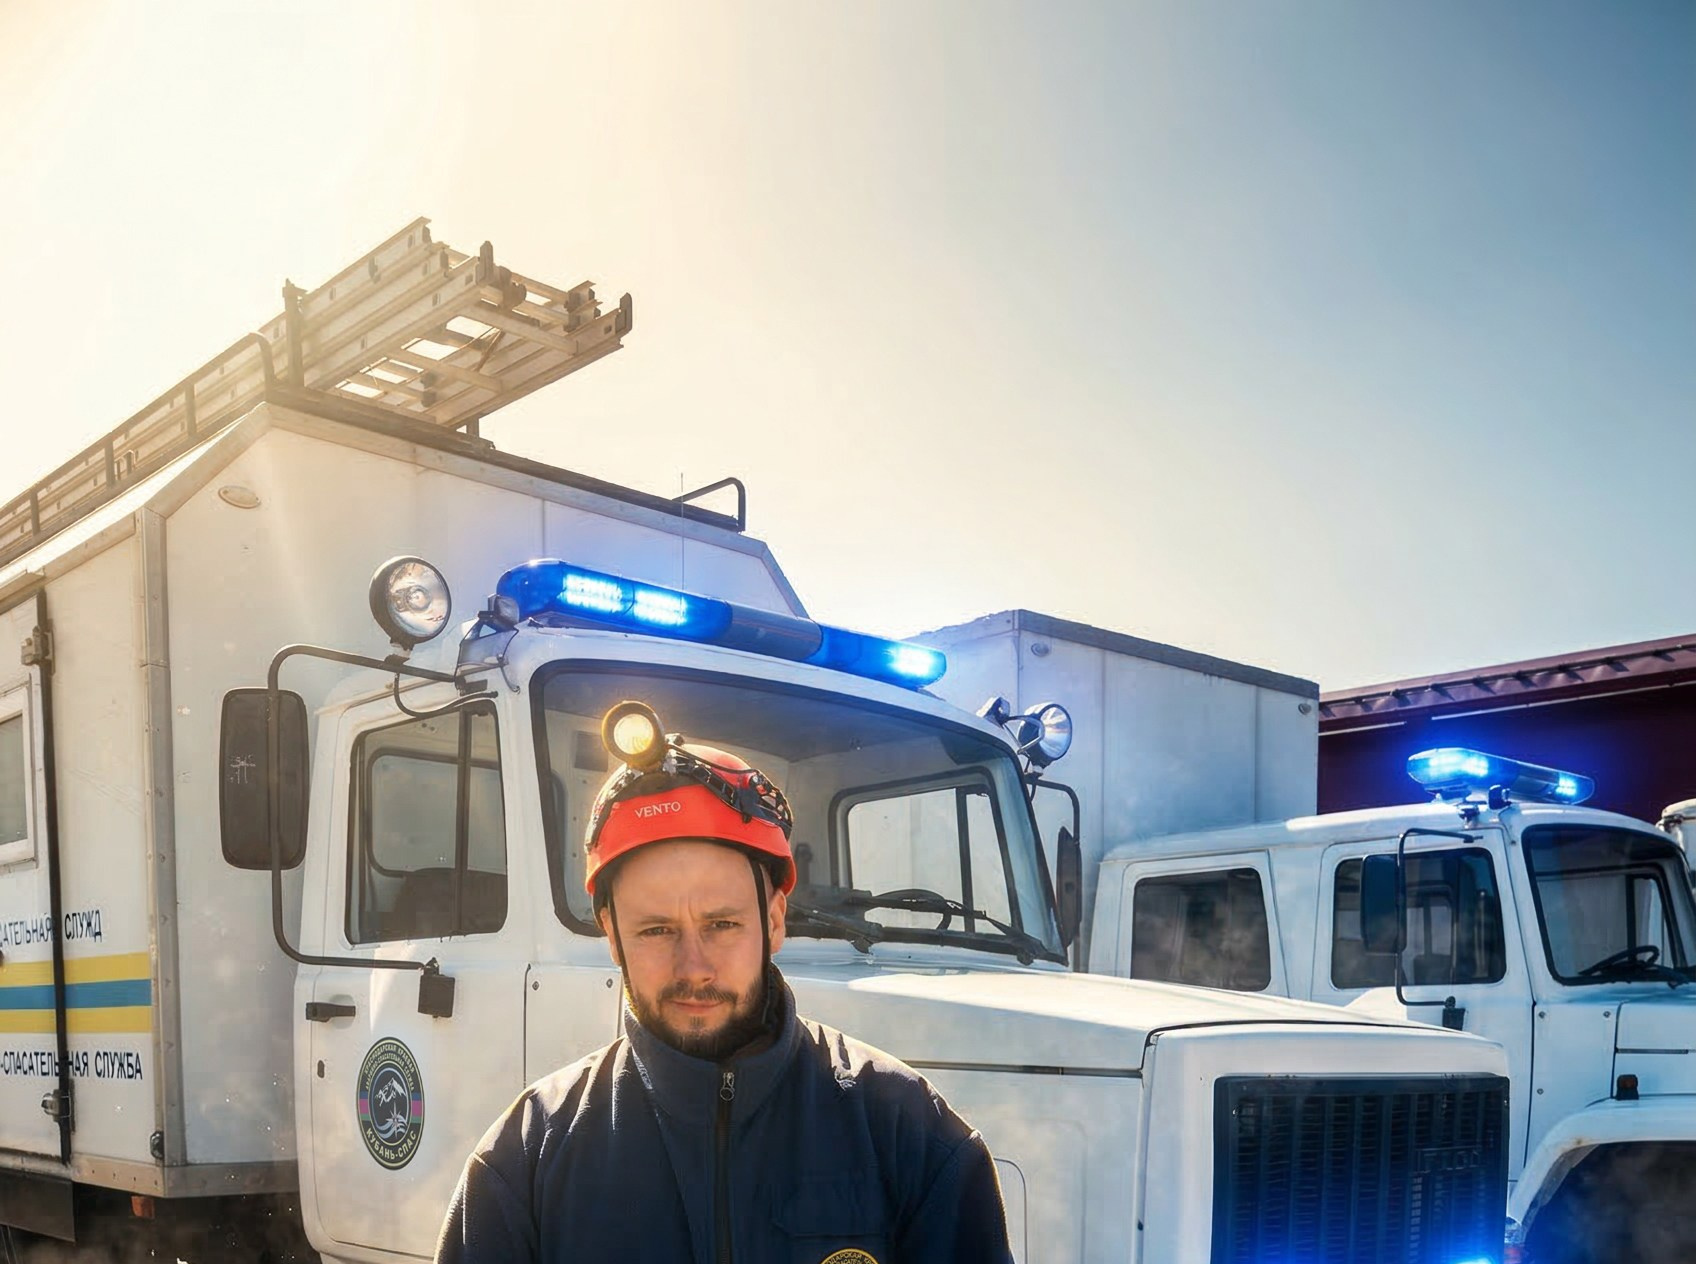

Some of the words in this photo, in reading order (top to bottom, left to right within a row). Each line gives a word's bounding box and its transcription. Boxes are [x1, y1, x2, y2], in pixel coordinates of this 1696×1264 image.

[634, 801, 682, 818] VENTO
[95, 1051, 143, 1080] СЛУЖБА
[366, 1129, 417, 1161] КУБАНЬ-СПАС
